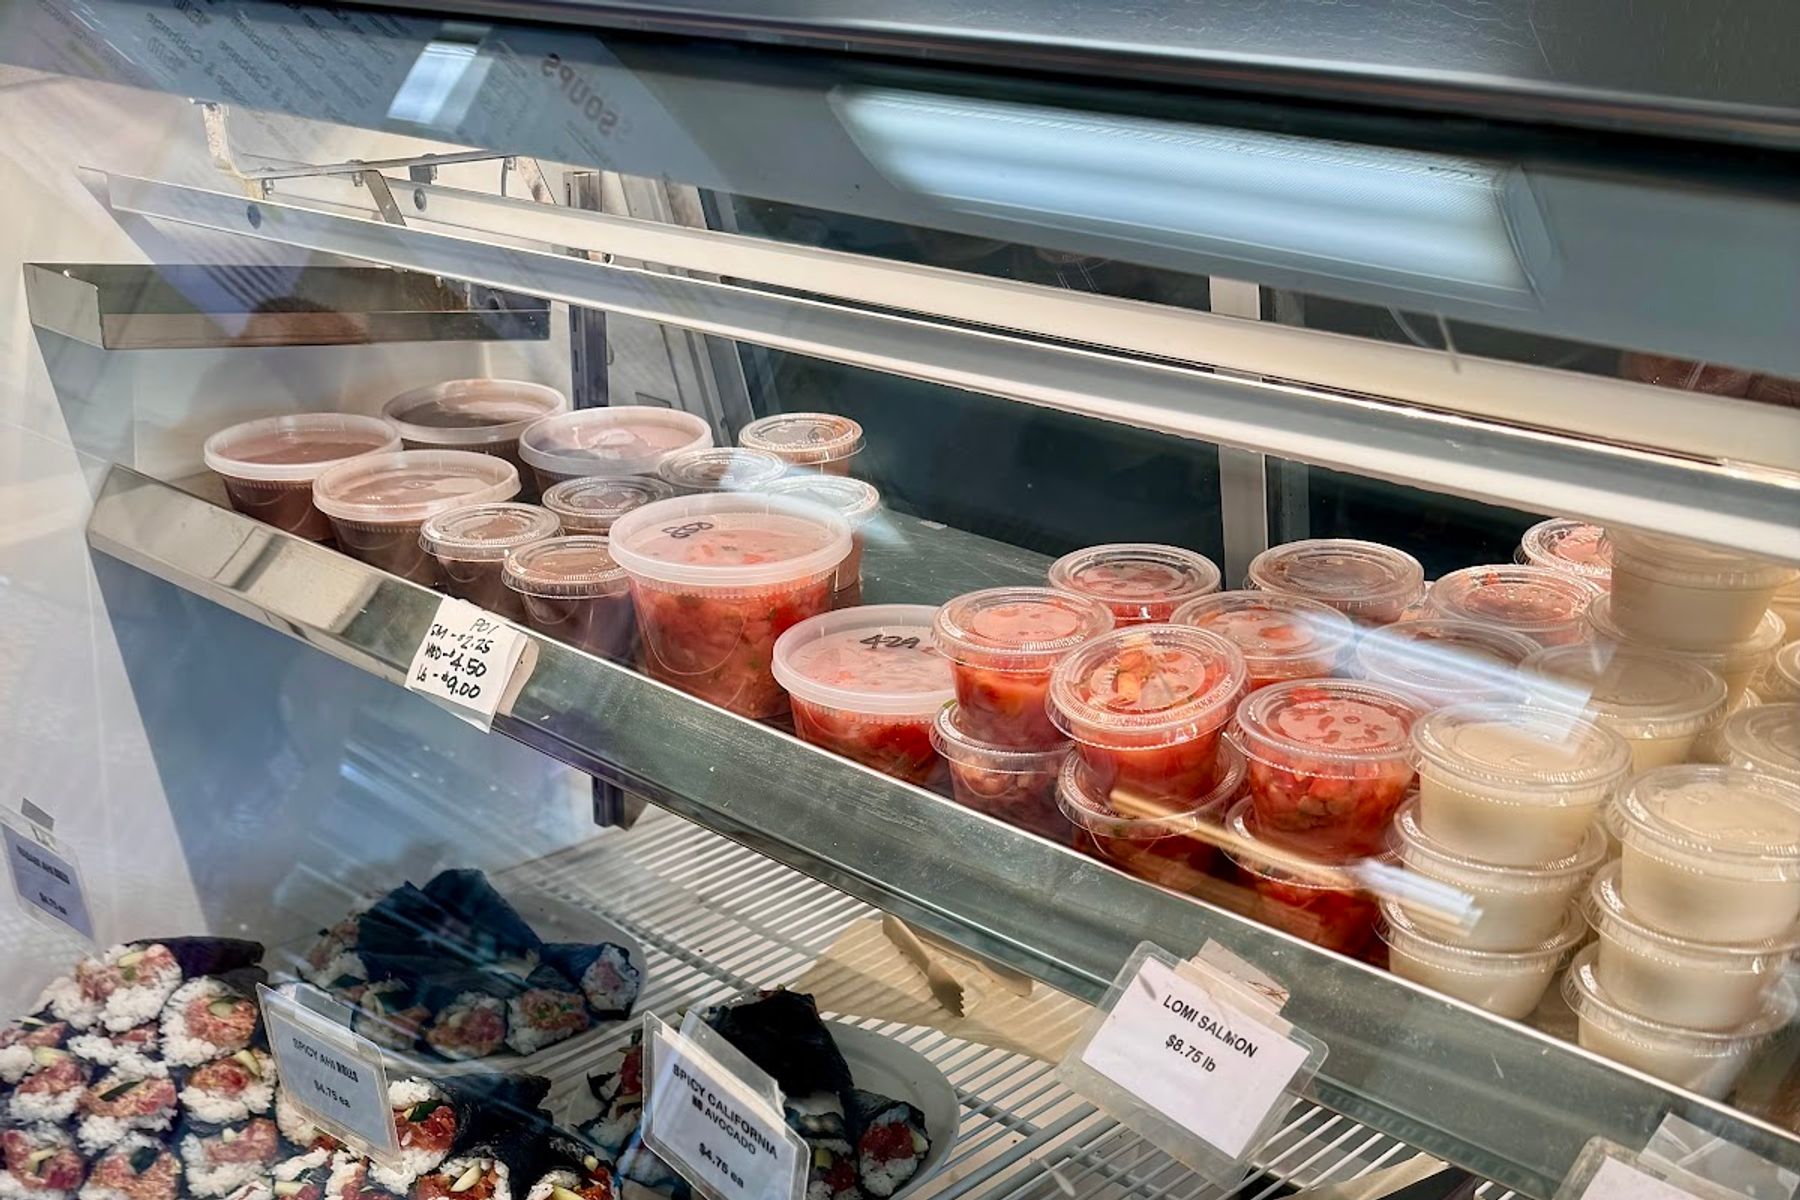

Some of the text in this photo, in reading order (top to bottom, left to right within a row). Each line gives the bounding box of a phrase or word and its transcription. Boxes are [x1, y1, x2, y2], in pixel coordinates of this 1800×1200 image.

[292, 1037, 318, 1061] SPICY
[1163, 994, 1259, 1058] LOMI SALMON
[1165, 1034, 1217, 1073] $8.75 lb
[672, 1063, 778, 1159] SPICY CALIFORNIA
[705, 1107, 756, 1155] AVOCADO
[699, 1143, 744, 1188] $4.75 ea
